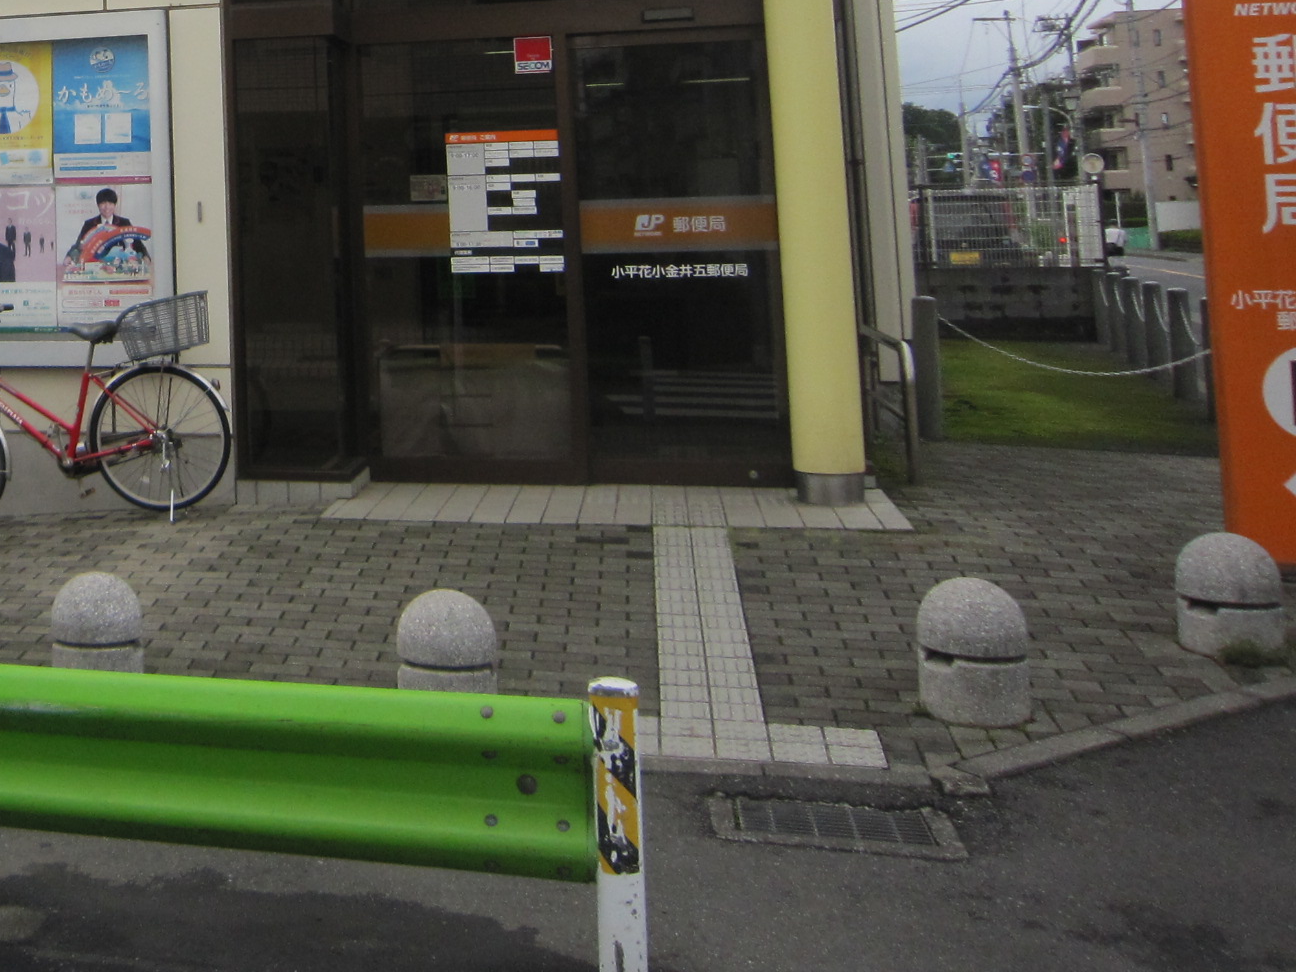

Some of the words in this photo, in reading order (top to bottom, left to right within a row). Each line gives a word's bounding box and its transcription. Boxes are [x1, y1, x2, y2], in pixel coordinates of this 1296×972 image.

[516, 61, 550, 71] SECOM
[672, 215, 726, 232] 郵便局
[611, 263, 749, 278] 小平花小金井五郵便局
